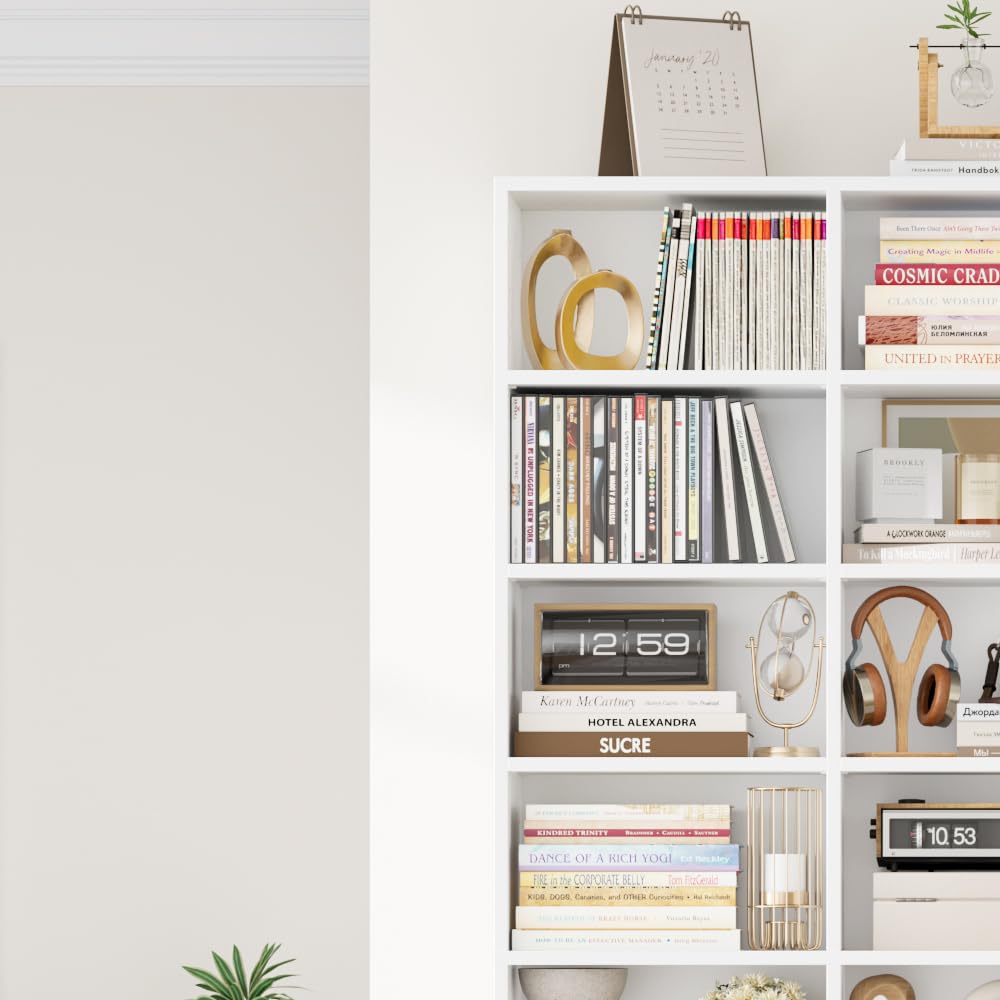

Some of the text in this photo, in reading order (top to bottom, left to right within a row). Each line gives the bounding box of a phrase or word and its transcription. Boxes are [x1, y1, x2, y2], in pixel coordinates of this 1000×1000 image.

[888, 248, 924, 256] Creating
[926, 248, 952, 256] Magic
[965, 248, 994, 256] Midlife
[882, 267, 948, 284] COSMIC
[885, 353, 937, 364] UNITED
[940, 355, 952, 364] IN
[891, 530, 923, 538] CLOCKWORK
[924, 530, 947, 538] ORANGE
[960, 547, 987, 561] Harper
[579, 633, 690, 656] 12 59
[540, 696, 636, 709] Karen McCartney
[588, 718, 697, 727] HOTEL ALEXANDRA
[599, 737, 651, 753] SUCRE
[974, 749, 989, 757] МЫ
[953, 827, 976, 845] 53
[529, 853, 571, 864] DANCE
[575, 853, 590, 864] OF
[595, 853, 604, 864] A
[608, 853, 637, 864] RICH
[642, 853, 672, 864] YOGI
[533, 875, 548, 885] FIRE
[549, 875, 558, 885] in
[560, 875, 572, 885] the
[574, 875, 620, 885] CORPORATE
[622, 875, 645, 885] BELLY
[668, 875, 683, 885] Tom
